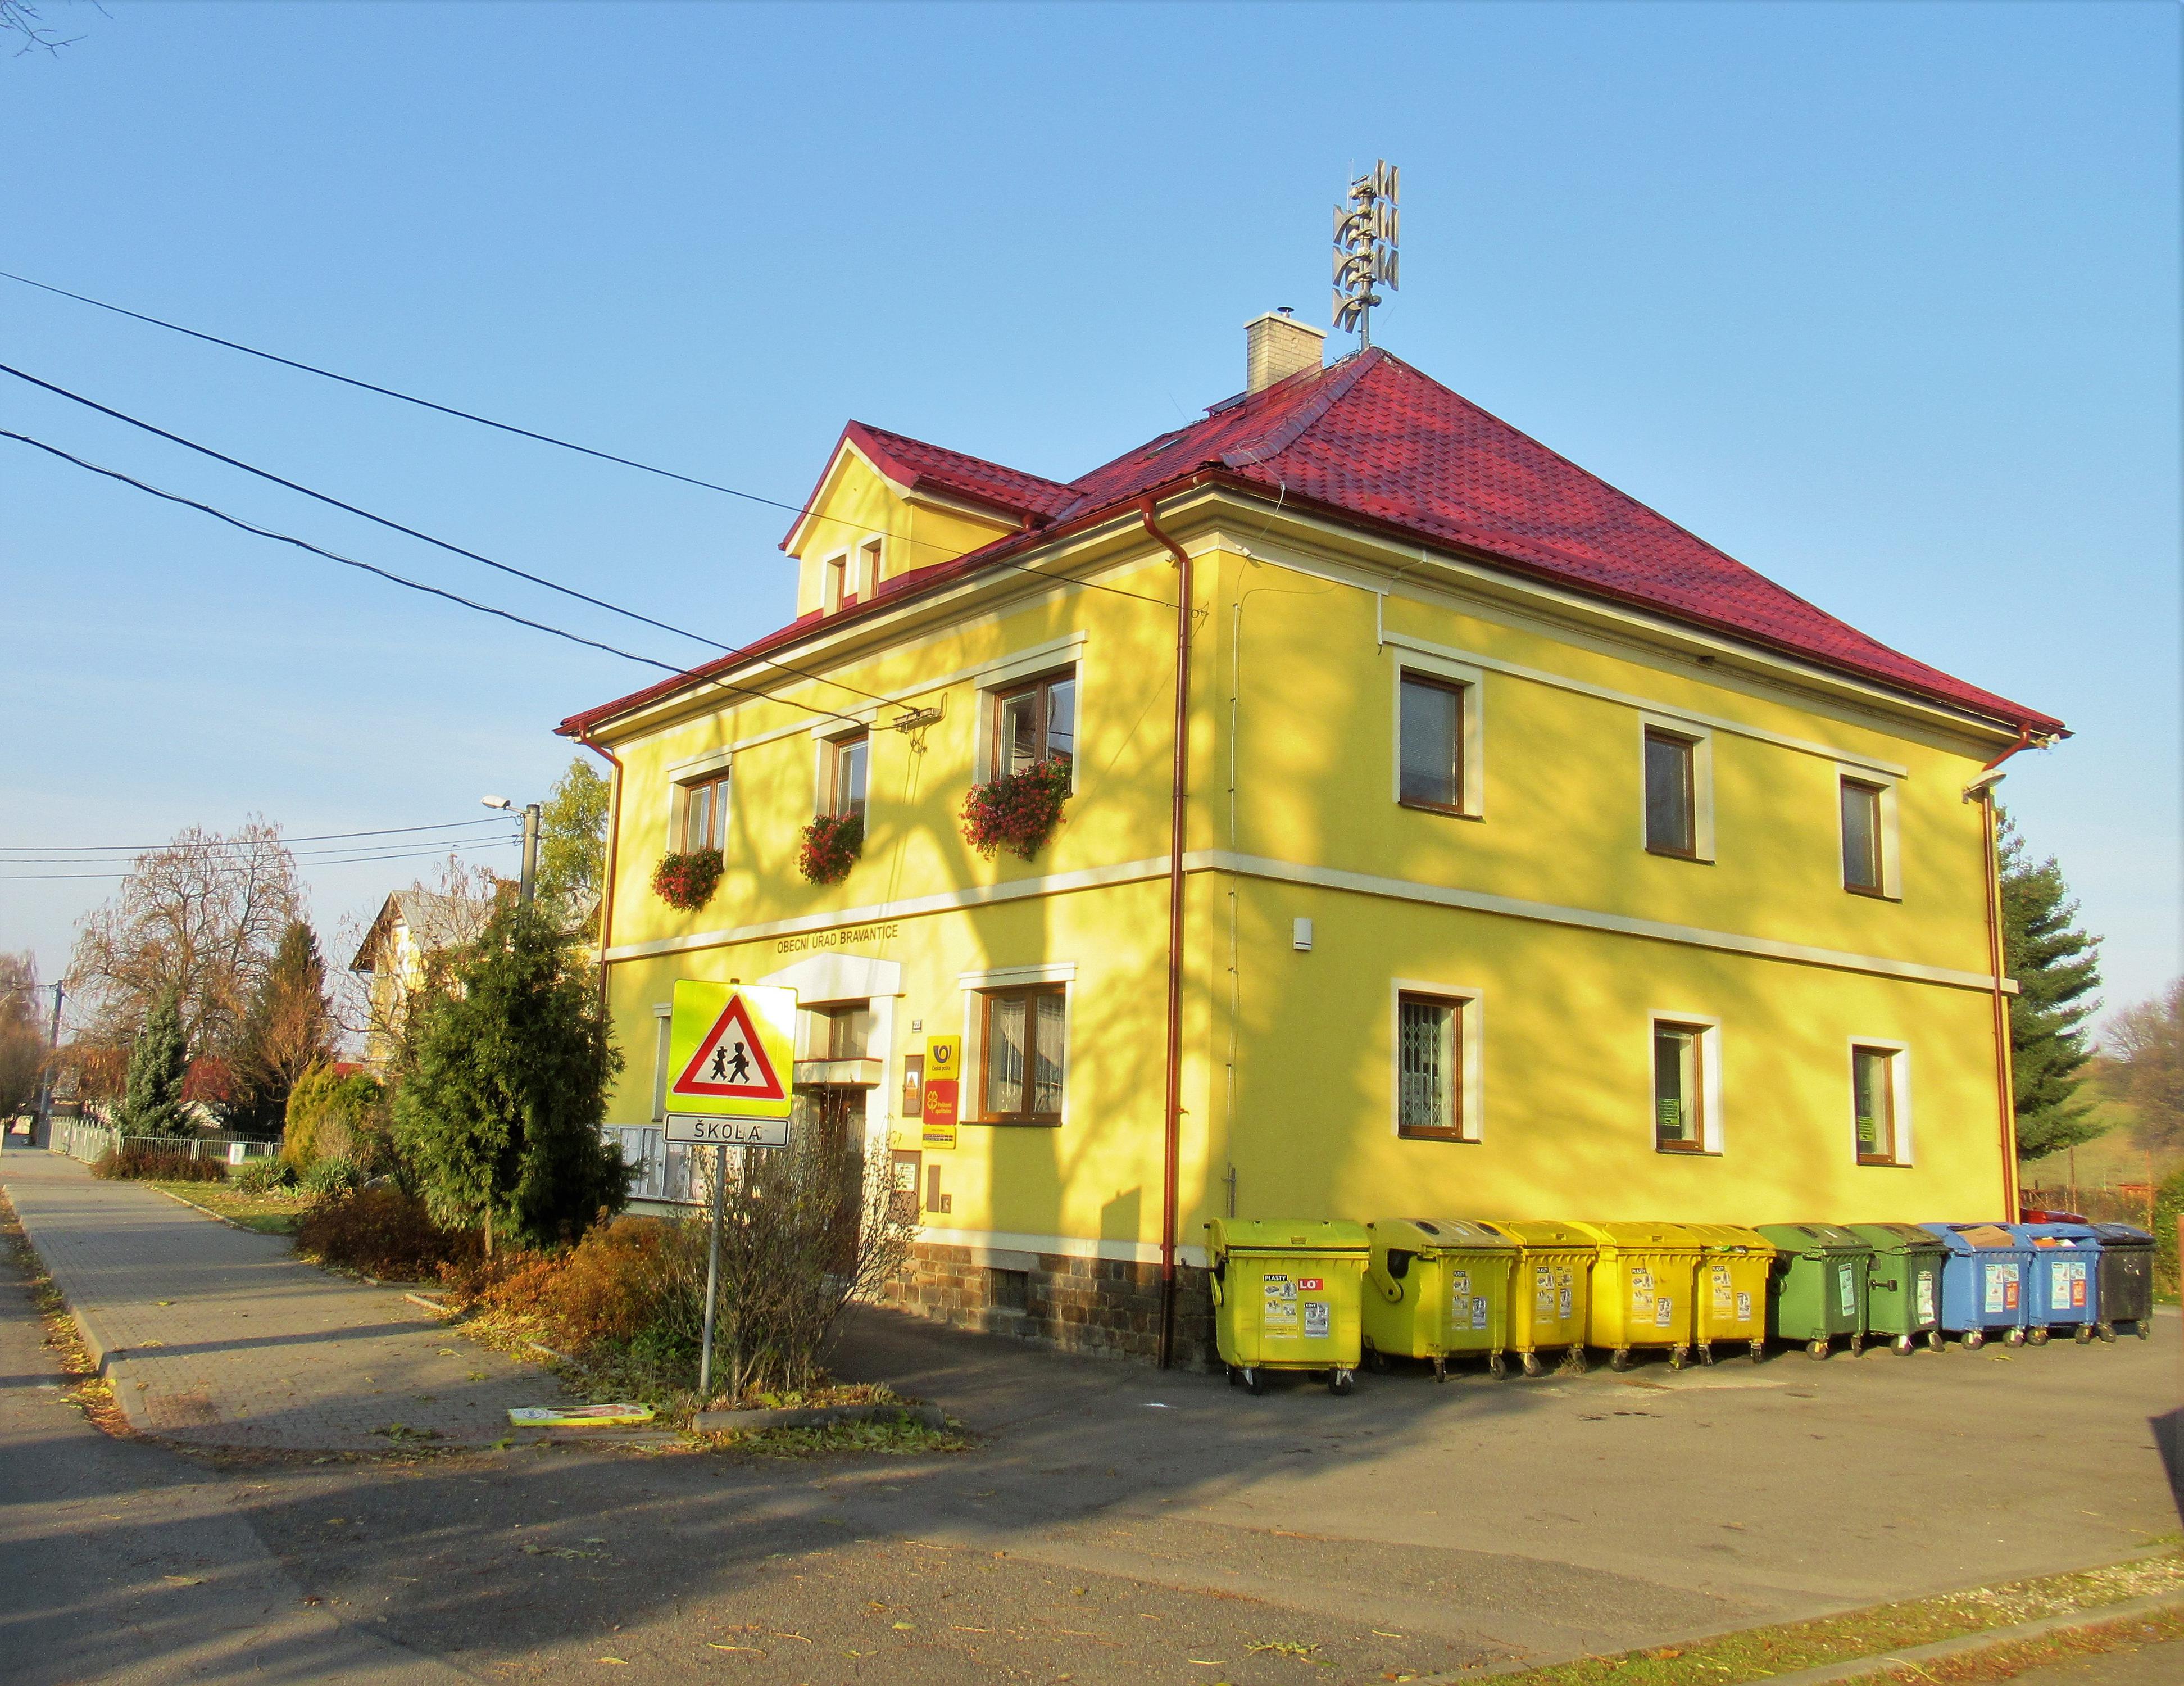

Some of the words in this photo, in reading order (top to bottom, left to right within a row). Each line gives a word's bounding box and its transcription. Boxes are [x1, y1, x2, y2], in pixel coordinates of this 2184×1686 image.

[777, 934, 809, 954] OBECNÍ
[812, 931, 837, 949] ÚŘAD
[840, 924, 899, 945] BRAVANTICE
[693, 1119, 760, 1140] ŠKOLA
